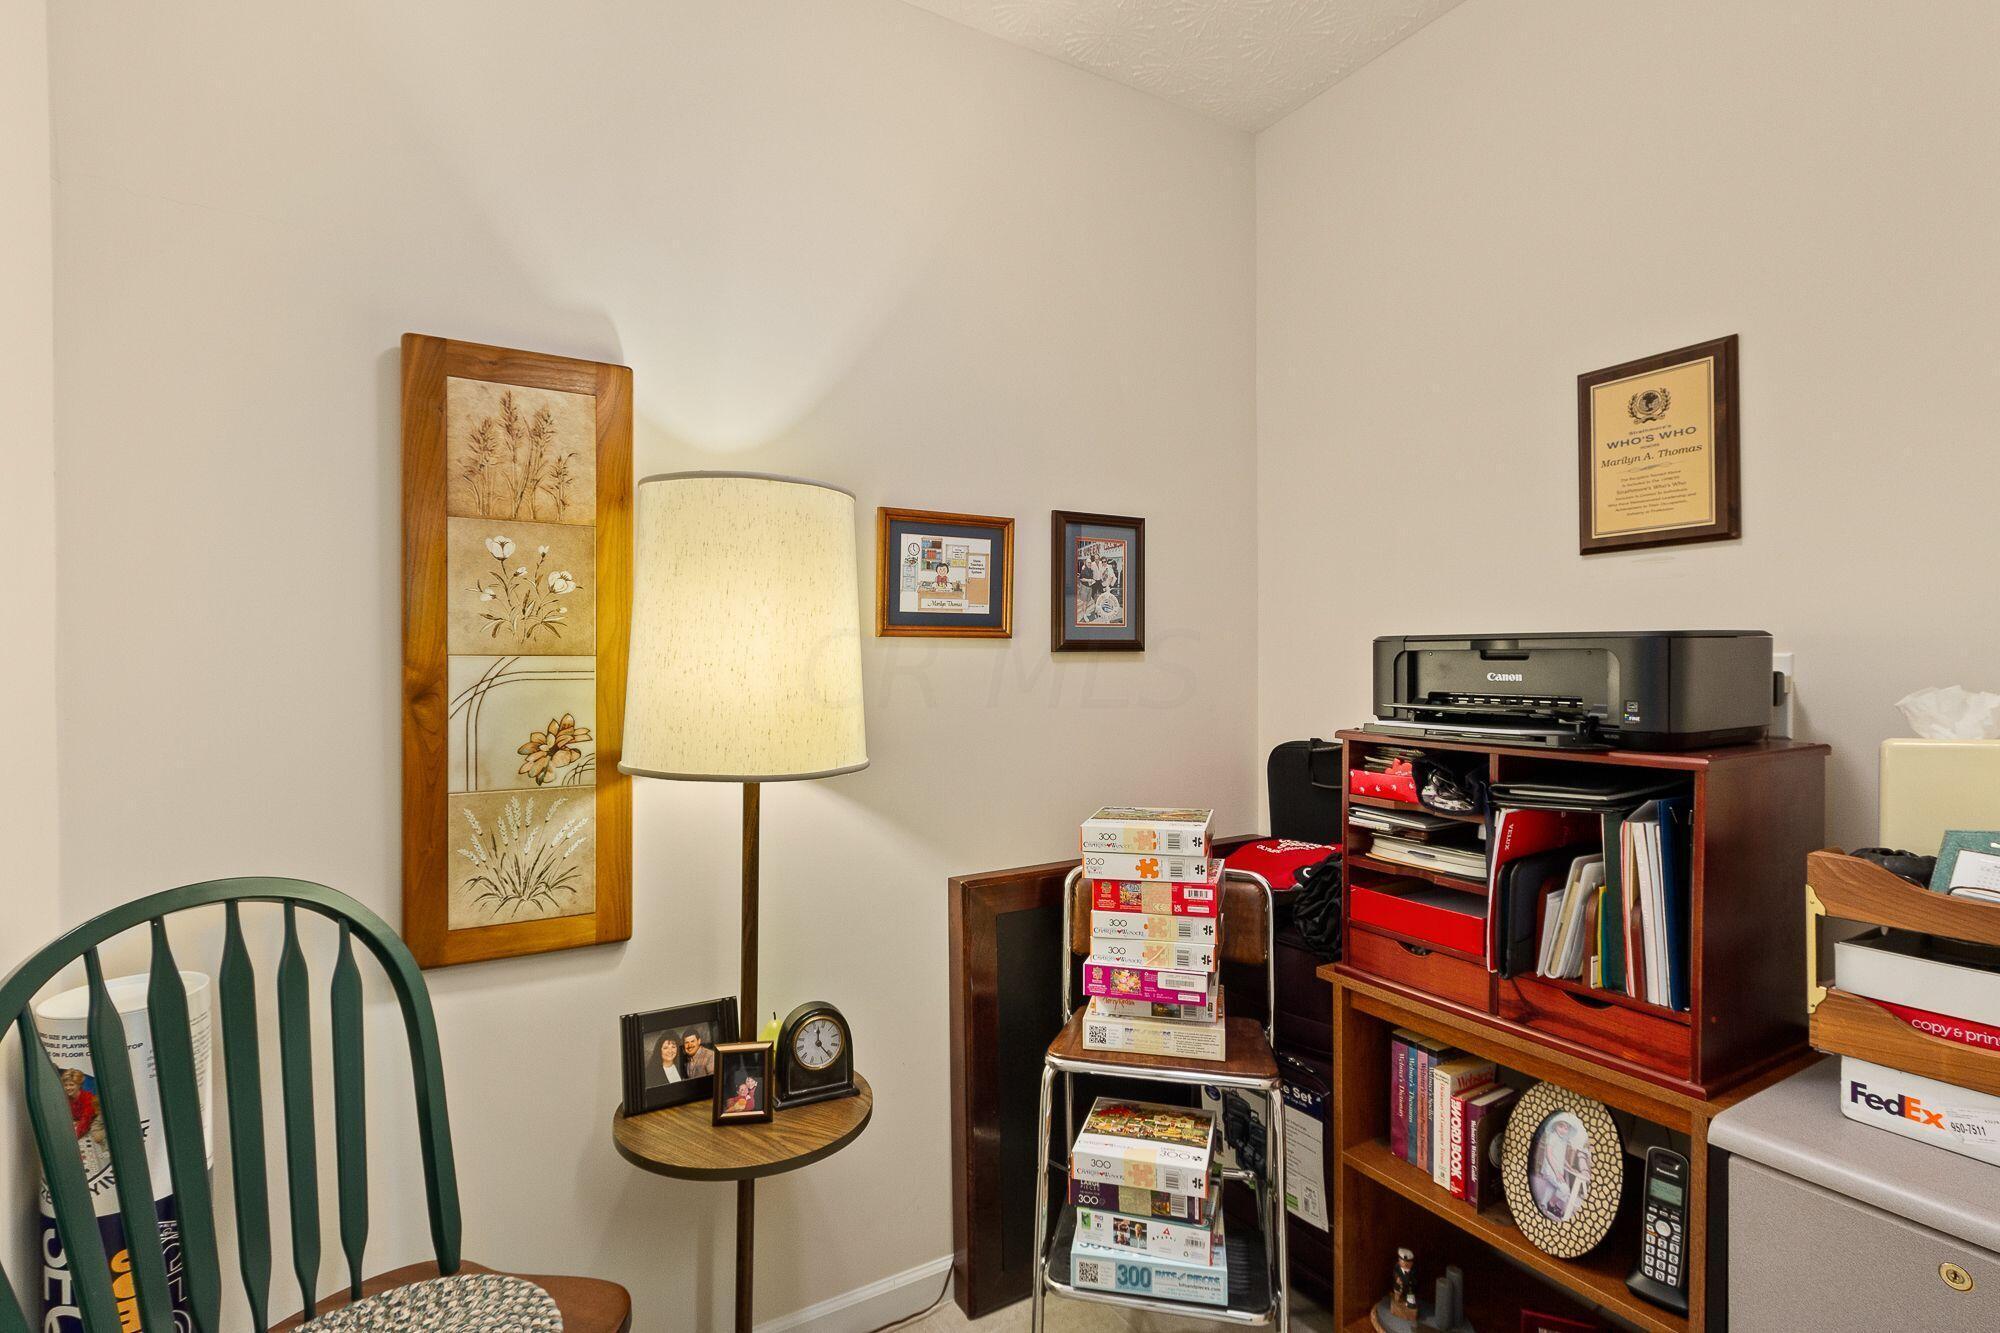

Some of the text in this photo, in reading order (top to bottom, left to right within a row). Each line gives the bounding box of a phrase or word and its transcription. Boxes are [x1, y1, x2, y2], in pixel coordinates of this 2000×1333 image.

[1606, 434, 1655, 449] WHO'S
[1659, 426, 1697, 440] WHO
[1601, 455, 1641, 468] Marilyn
[1643, 452, 1654, 461] A.
[1658, 444, 1703, 458] Thomas
[1487, 672, 1523, 682] Canon
[1099, 832, 1117, 841] 300
[1085, 857, 1105, 866] 300
[1109, 918, 1128, 928] 300
[1107, 946, 1127, 955] 300
[1911, 1019, 2000, 1047] copy & prin
[1292, 1087, 1313, 1105] Set
[1850, 1080, 1946, 1131] FedEx
[1451, 1104, 1462, 1143] WORD
[1950, 1121, 1987, 1137] 950-7511
[1090, 1158, 1112, 1170] 300
[1451, 1142, 1463, 1180] BOOK
[1078, 1193, 1099, 1205] 300
[1117, 1264, 1152, 1288] 300
